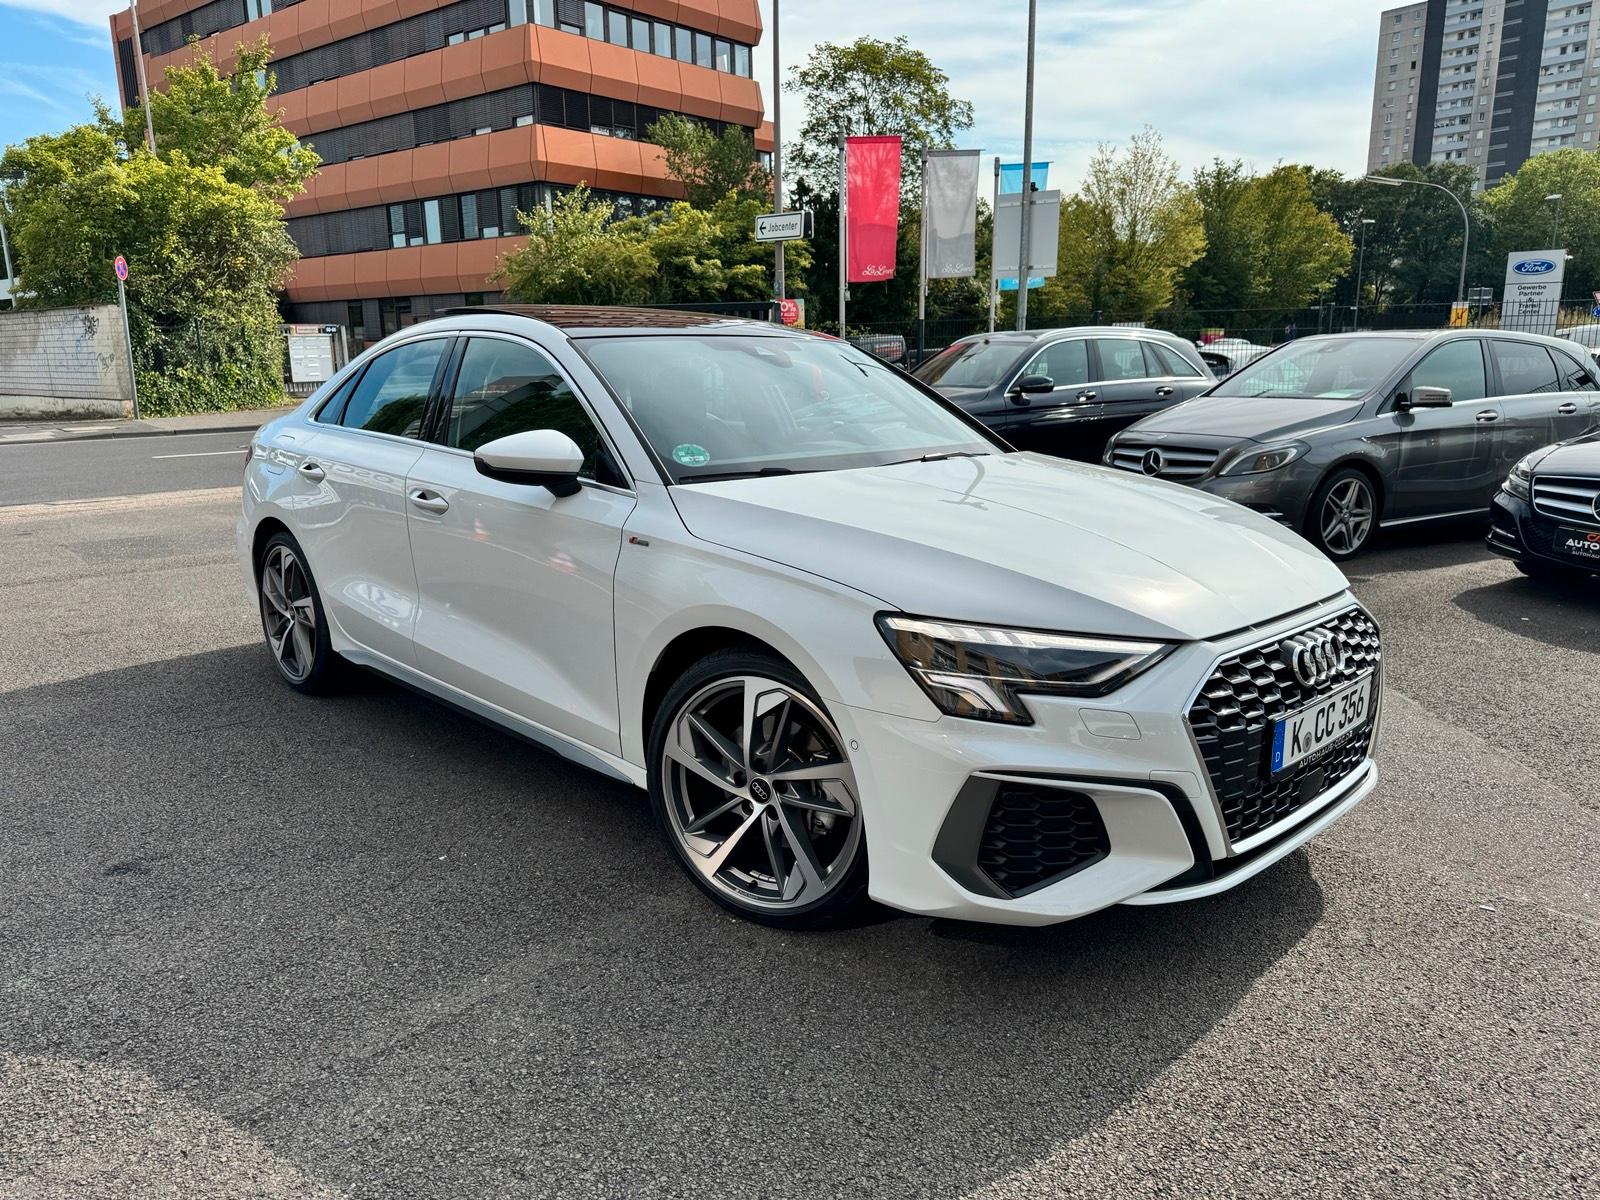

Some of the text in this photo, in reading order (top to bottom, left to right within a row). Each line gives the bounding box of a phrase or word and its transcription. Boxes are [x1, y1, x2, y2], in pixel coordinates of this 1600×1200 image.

[768, 222, 798, 232] Jobcenter
[1521, 261, 1547, 272] Ford
[1566, 538, 1600, 550] AUTO
[1291, 685, 1365, 757] K CC 356
[1275, 751, 1281, 763] D
